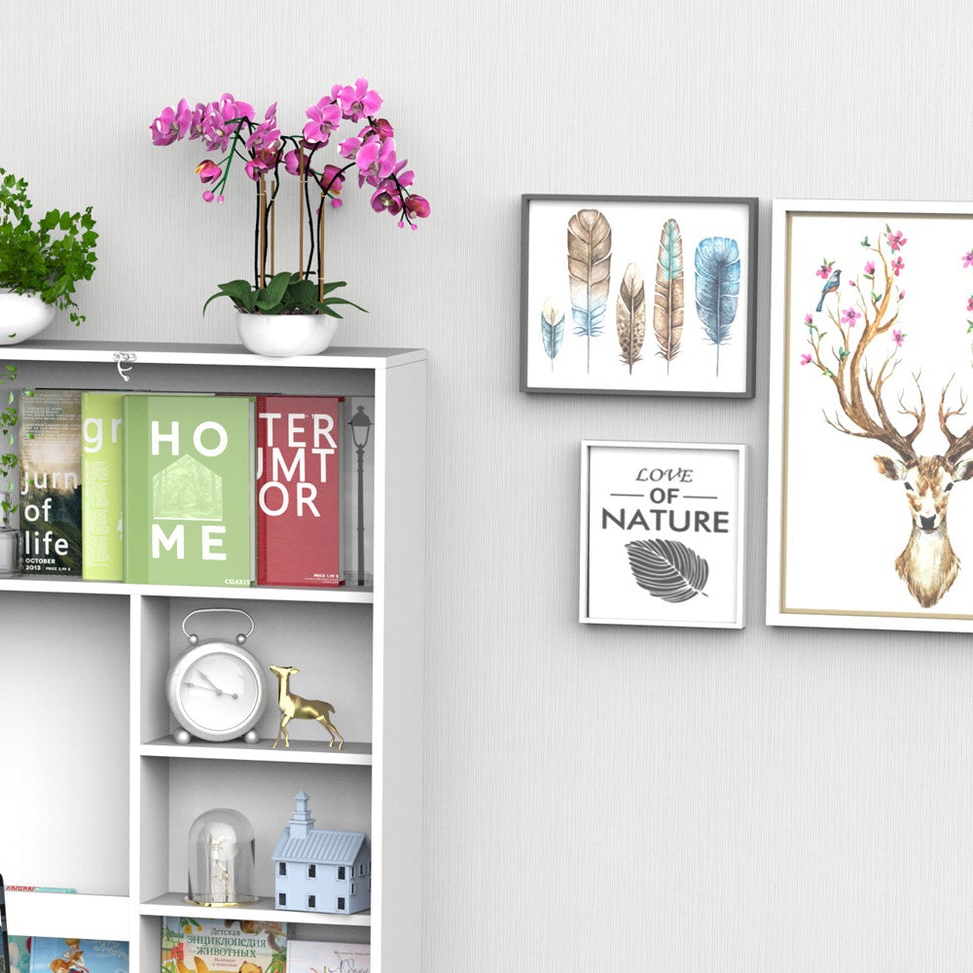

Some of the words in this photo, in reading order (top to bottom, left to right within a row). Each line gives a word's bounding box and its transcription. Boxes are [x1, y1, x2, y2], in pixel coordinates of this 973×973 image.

[82, 417, 122, 453] gr
[151, 421, 229, 457] HO
[258, 413, 338, 449] TER
[635, 467, 693, 483] LOVE
[258, 481, 321, 518] OR
[649, 487, 680, 504] OF
[24, 497, 52, 522] of
[602, 507, 729, 533] NATURE
[25, 530, 69, 556] life
[151, 524, 227, 561] ME
[187, 935, 267, 948] ЭНЦИКЛОПЕДИЯ
[210, 927, 241, 936] Детская
[196, 946, 257, 958] ЖИВОТНЫХ
